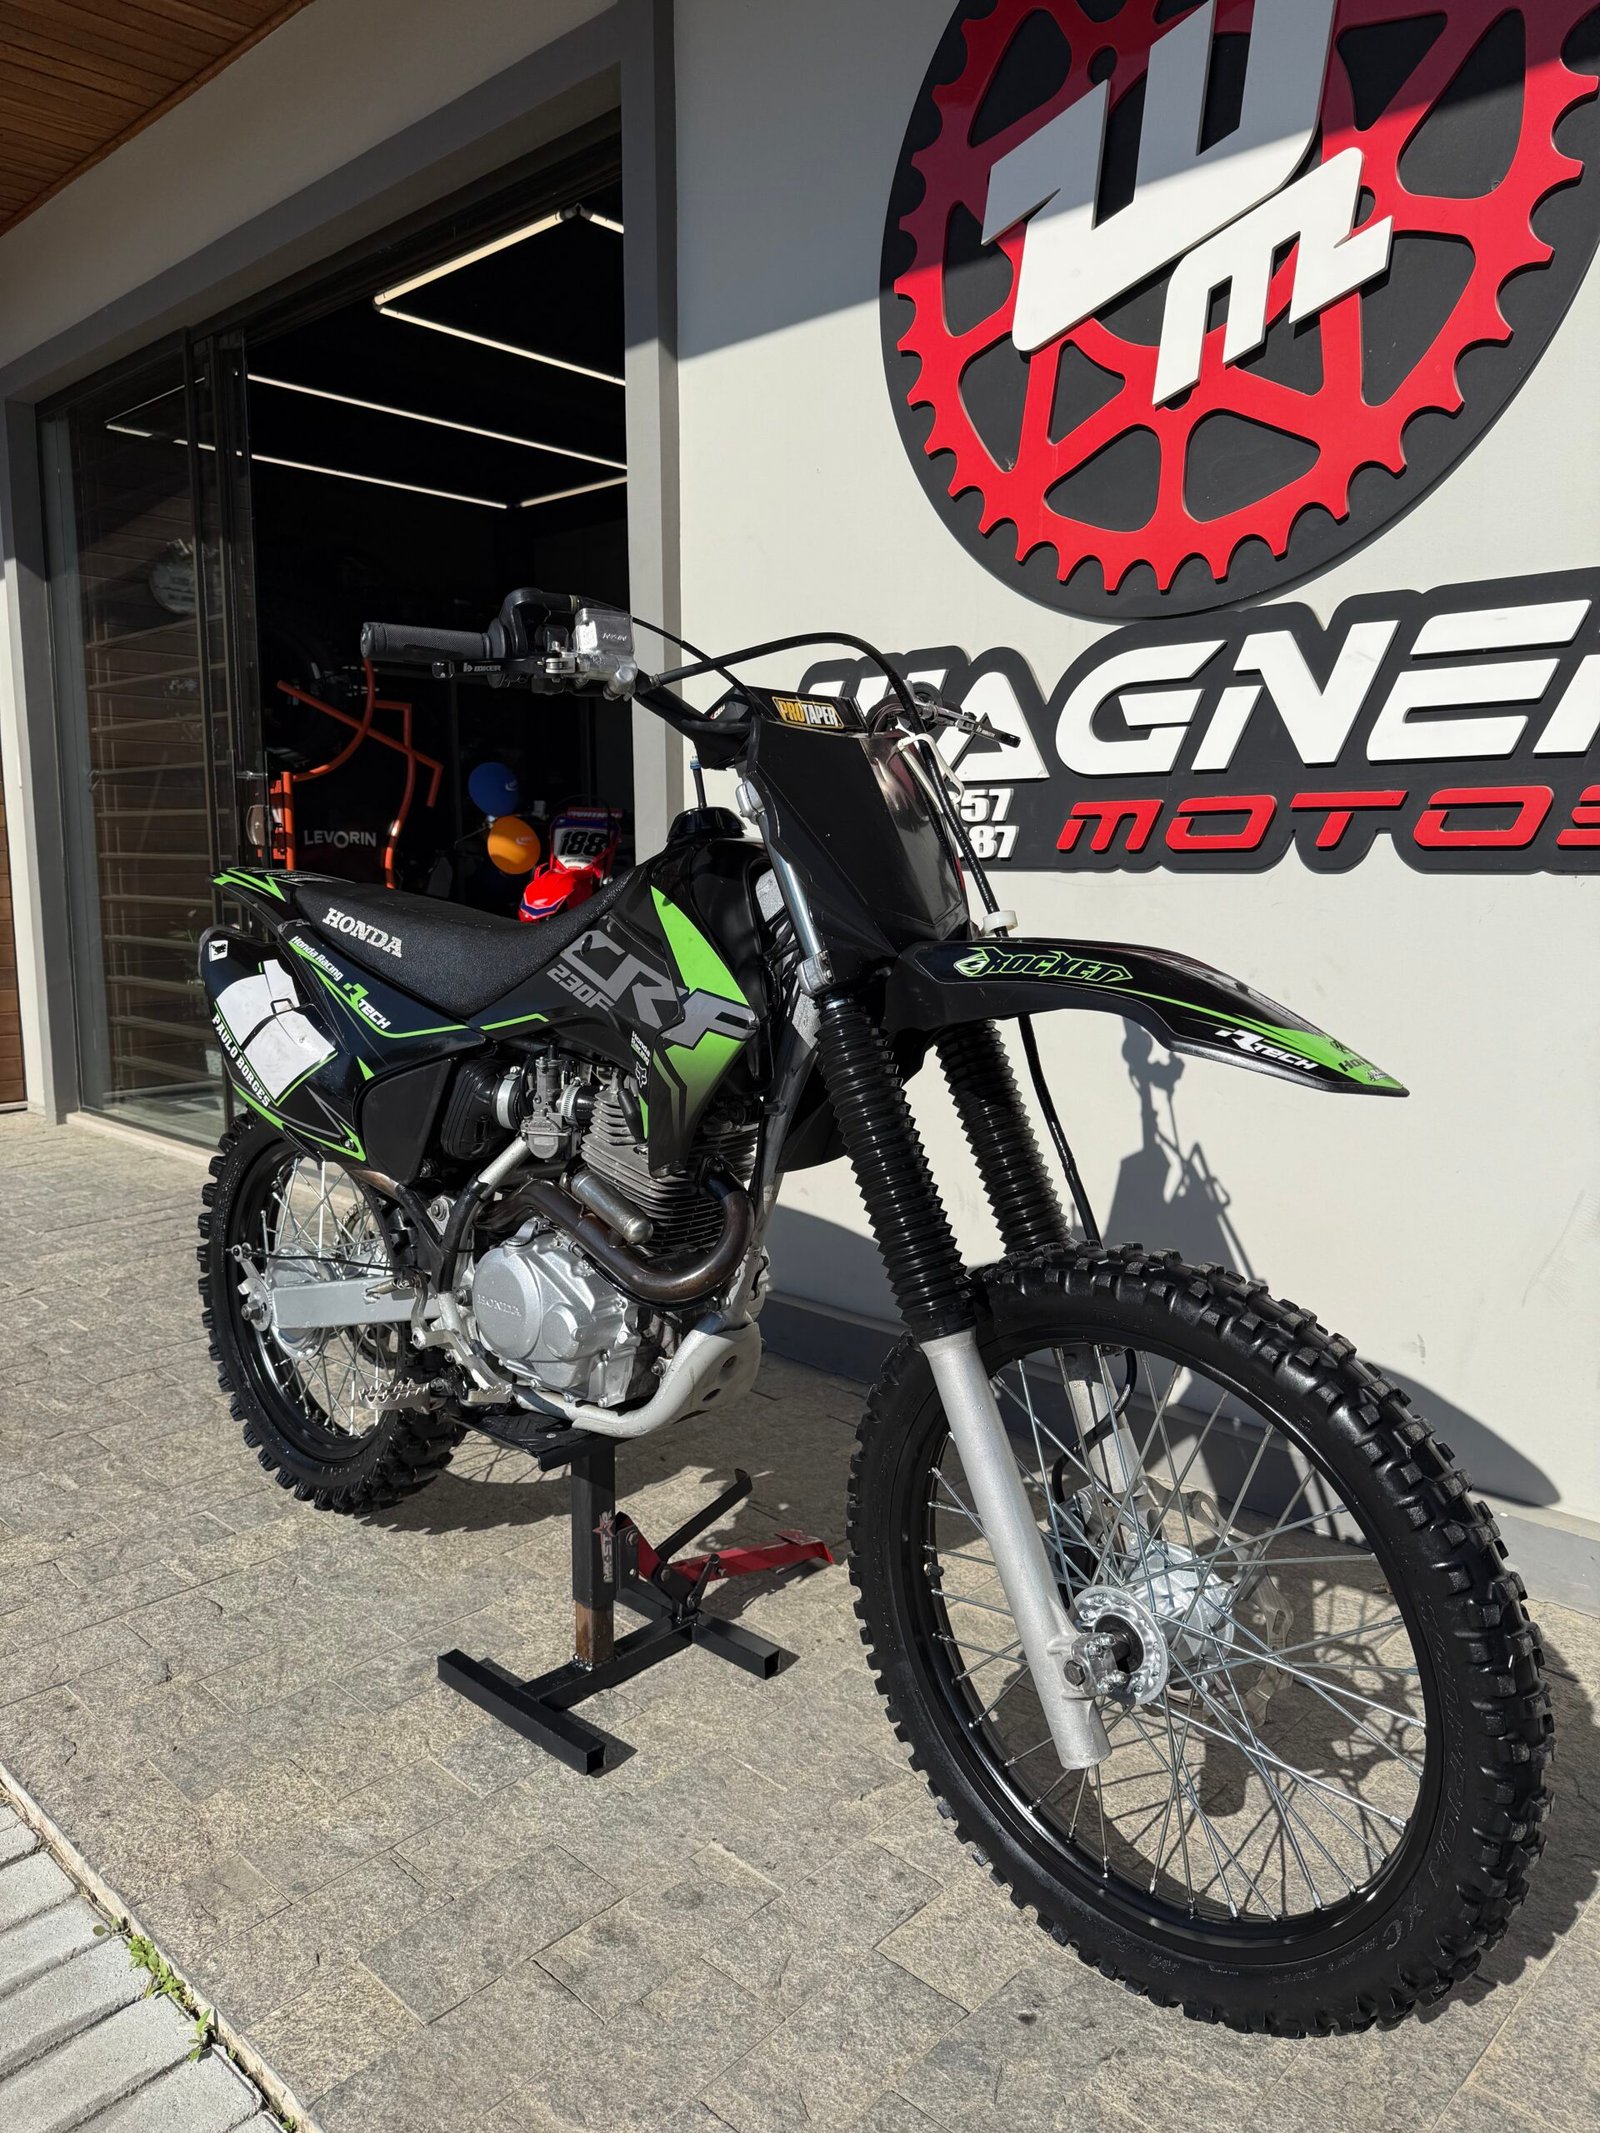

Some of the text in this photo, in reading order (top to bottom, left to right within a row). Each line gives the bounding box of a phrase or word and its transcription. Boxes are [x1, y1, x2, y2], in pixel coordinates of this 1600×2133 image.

[780, 701, 839, 727] PROTAPER
[304, 830, 377, 849] LEVORIN
[560, 831, 607, 857] 188
[322, 907, 404, 958] HONDA
[290, 935, 344, 981] Honda Racing
[546, 963, 616, 1012] 230F
[212, 1013, 240, 1059] PAULO
[235, 1058, 271, 1107] BORGES
[477, 1294, 522, 1318] HONDA
